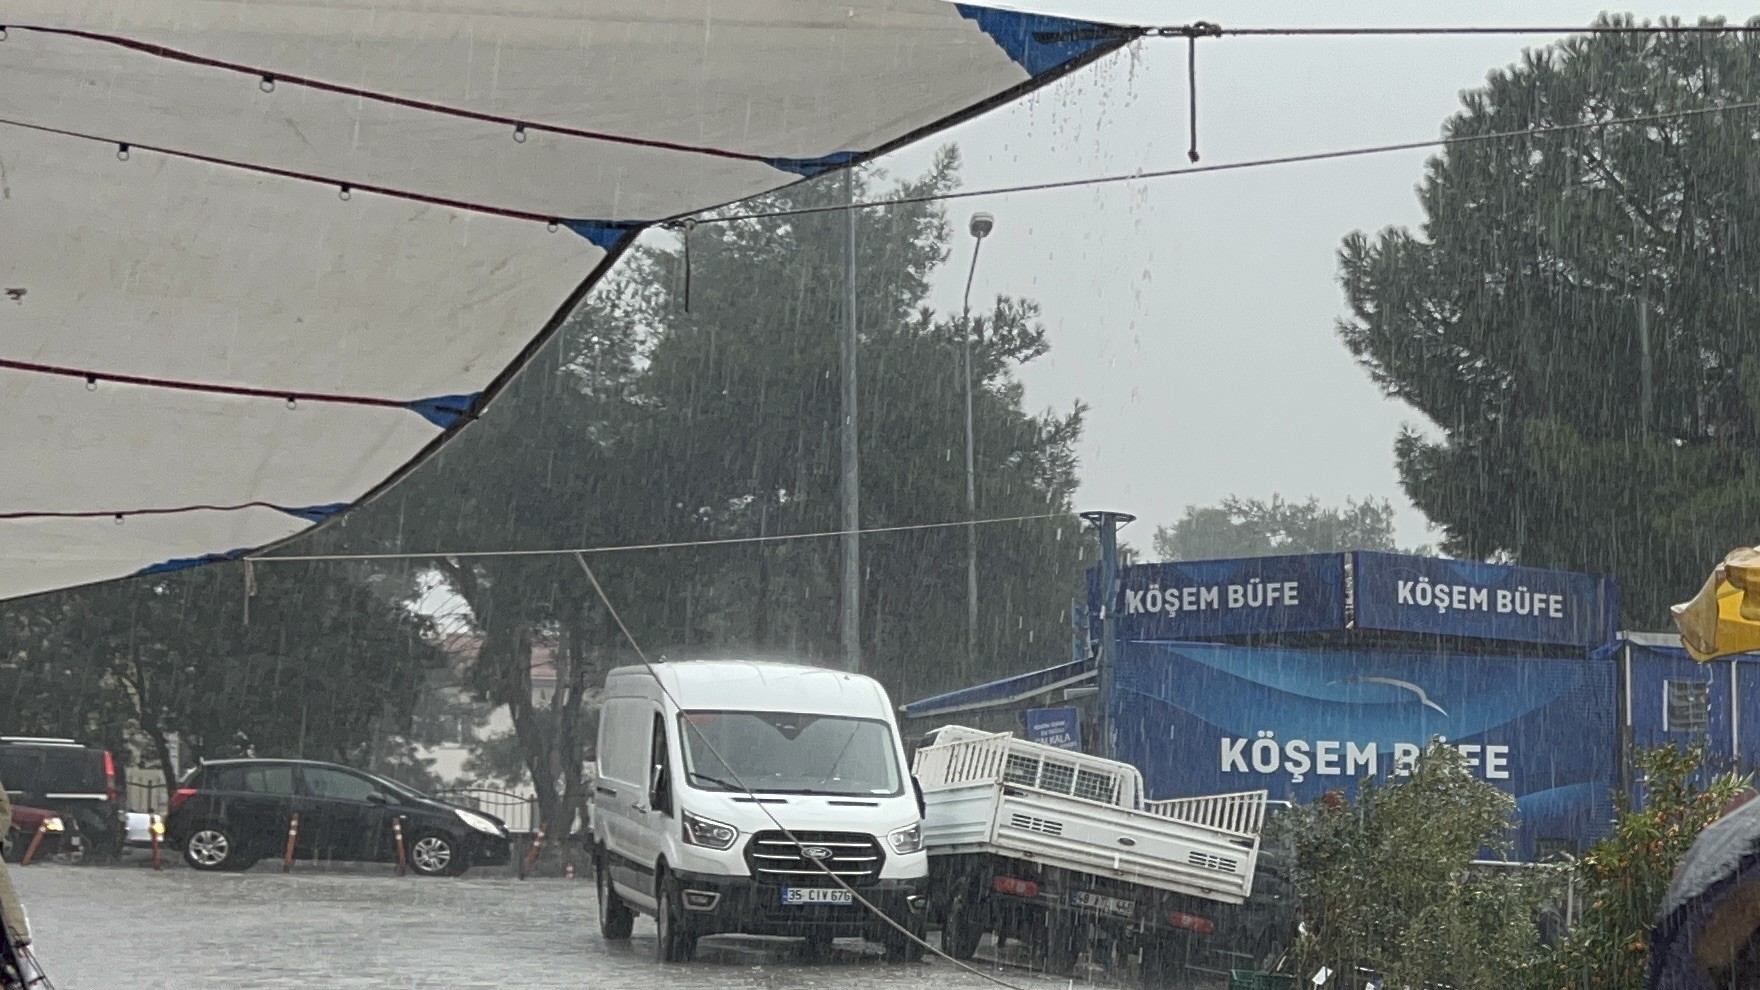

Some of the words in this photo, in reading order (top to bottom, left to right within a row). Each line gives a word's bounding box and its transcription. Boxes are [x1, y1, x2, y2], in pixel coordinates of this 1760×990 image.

[1127, 583, 1219, 618] KÖŞEM
[1227, 577, 1299, 609] BÜFE
[1397, 576, 1489, 614] KÖŞEM
[1496, 586, 1563, 618] BÜFE
[1220, 730, 1378, 783] KÖŞEM
[788, 889, 802, 900] 35
[831, 890, 851, 901] 676
